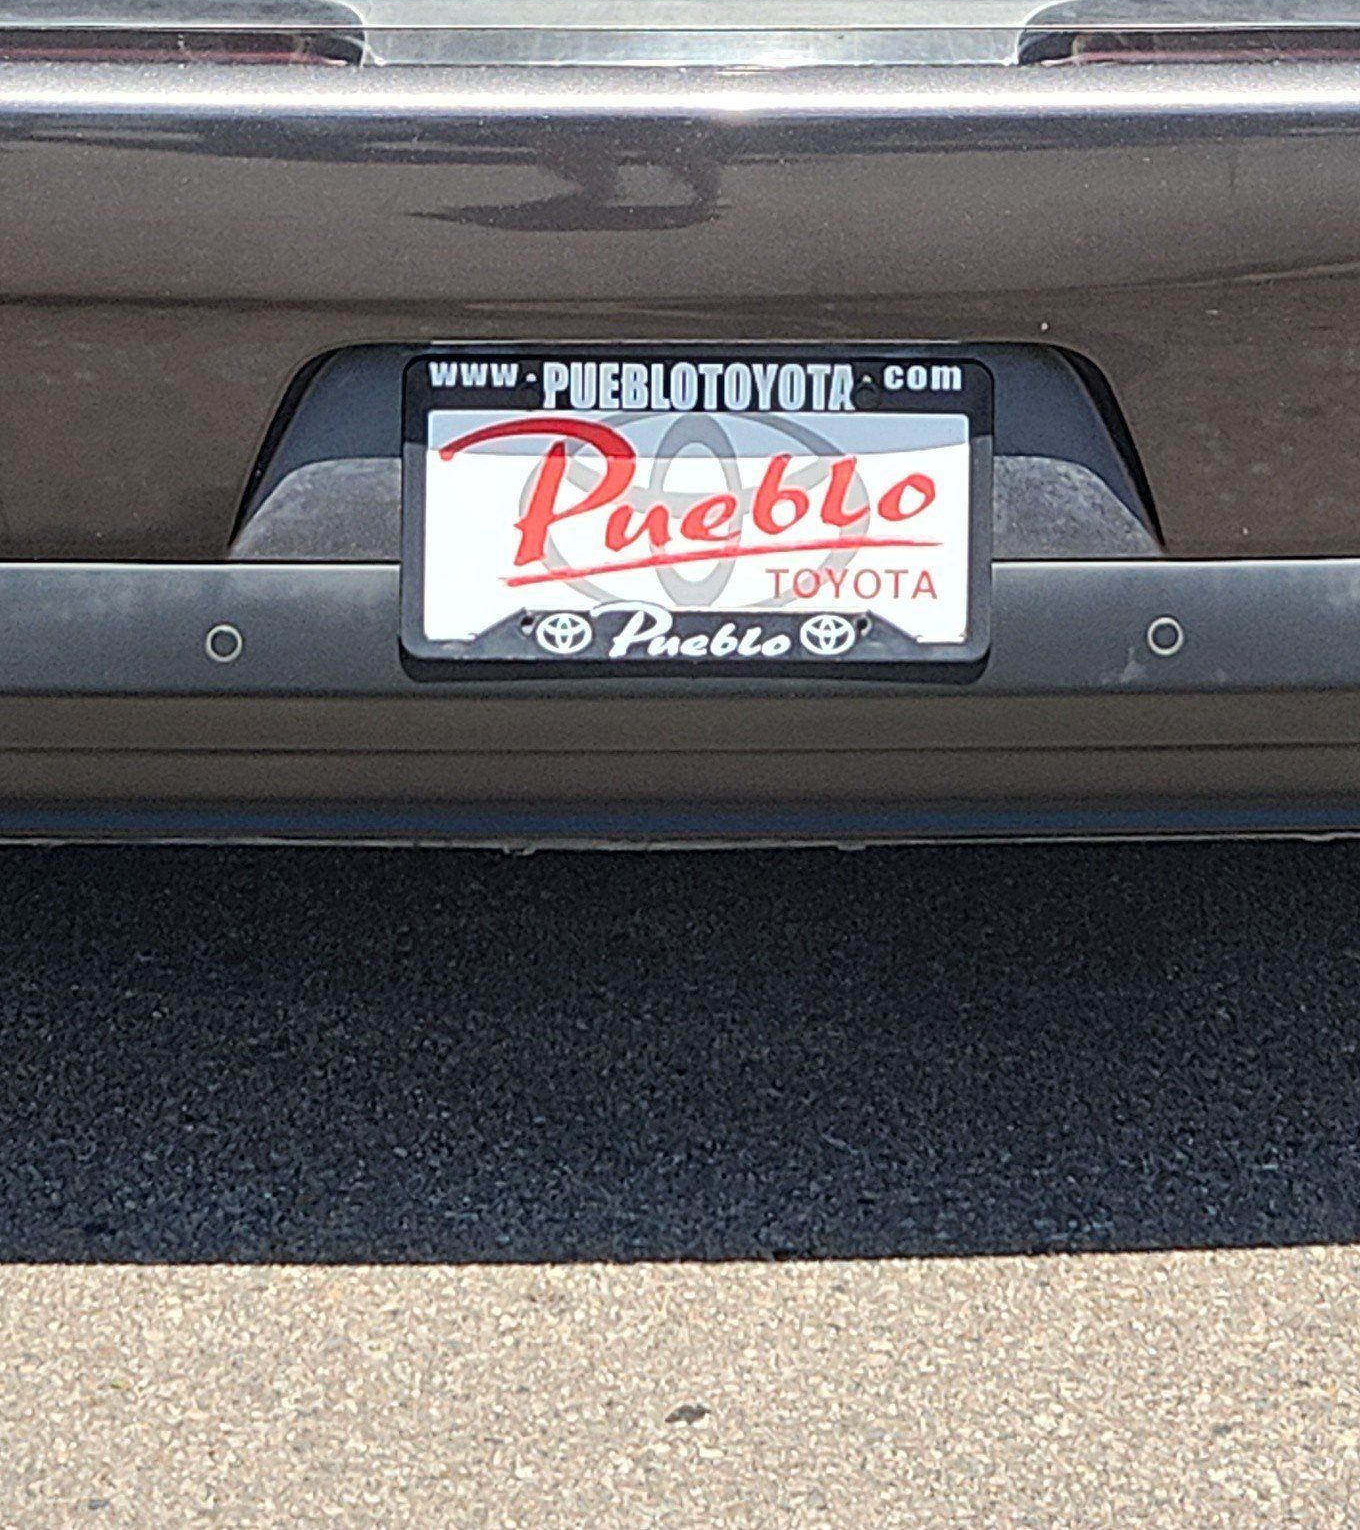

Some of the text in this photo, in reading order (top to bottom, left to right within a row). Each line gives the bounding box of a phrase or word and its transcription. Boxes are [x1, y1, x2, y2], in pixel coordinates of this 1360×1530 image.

[439, 416, 938, 566] Pueblo
[765, 568, 938, 600] TOYOTA
[590, 600, 792, 658] Pueblo
